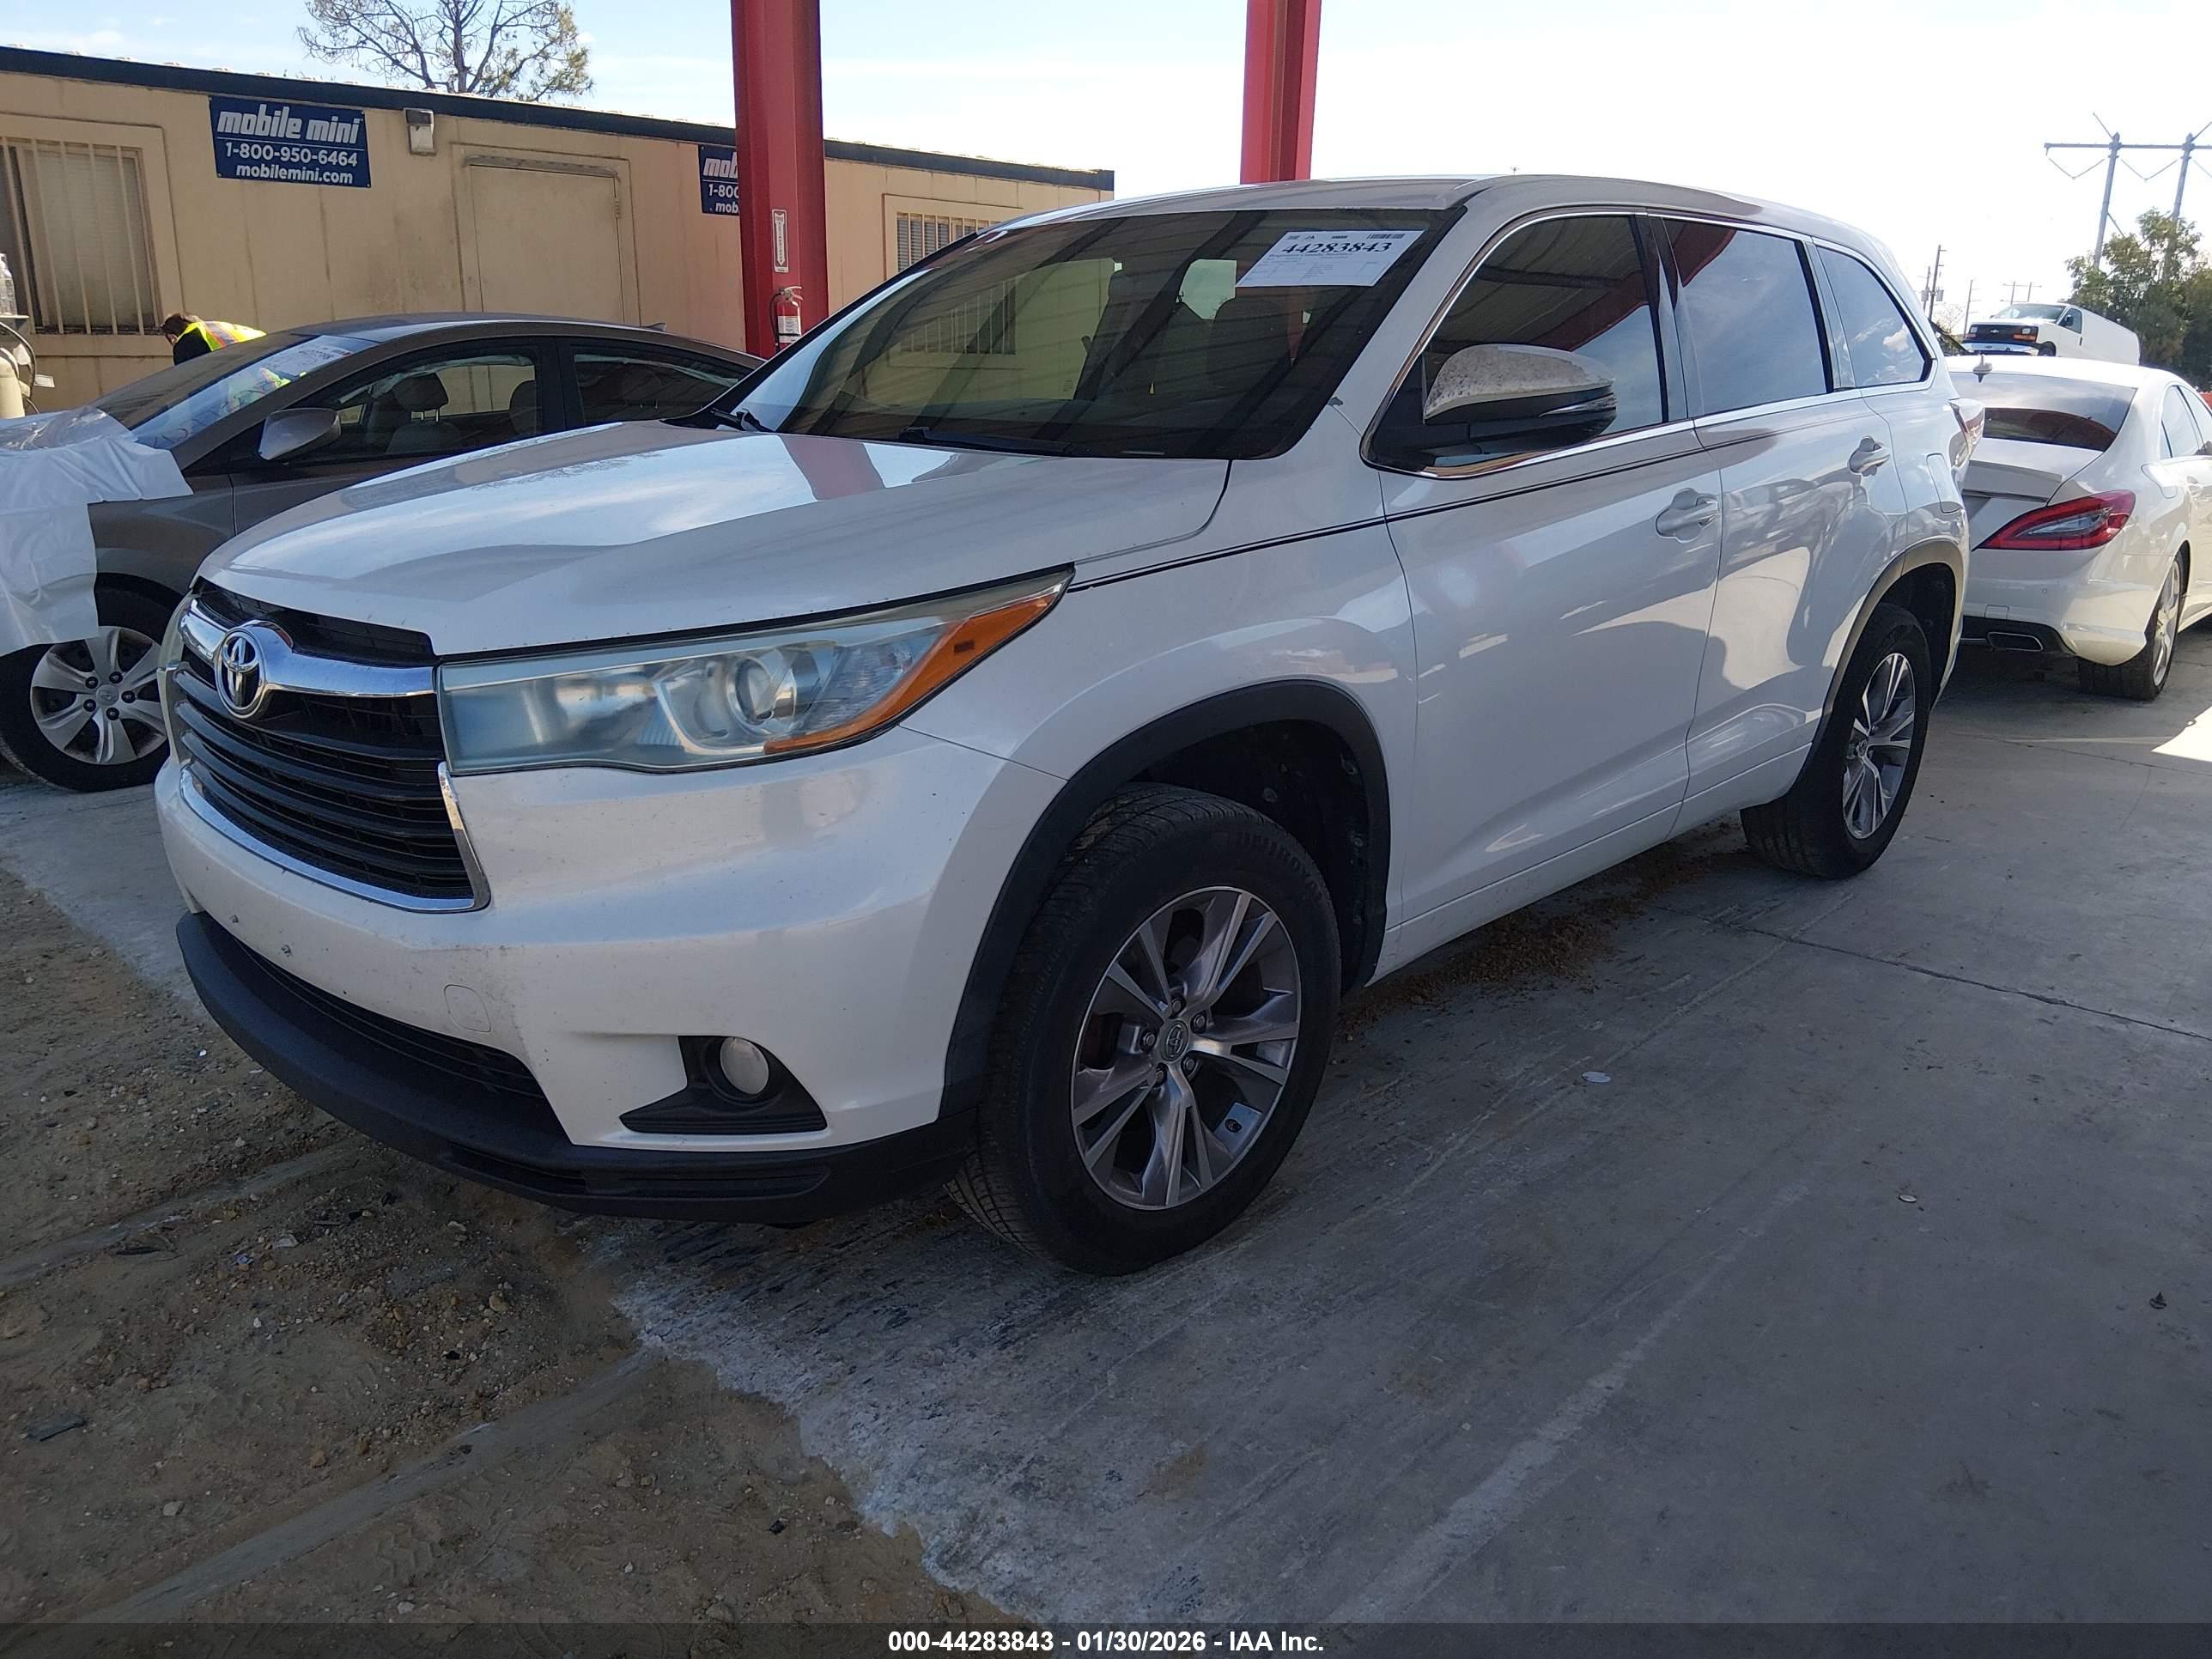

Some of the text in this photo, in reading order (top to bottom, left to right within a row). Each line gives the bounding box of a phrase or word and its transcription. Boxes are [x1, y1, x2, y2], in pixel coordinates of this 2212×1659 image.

[217, 104, 360, 144] mobile mini
[225, 142, 358, 167] 1-800-950-6464
[236, 163, 353, 184] mobilemini.com
[1282, 242, 1392, 254] 44283843
